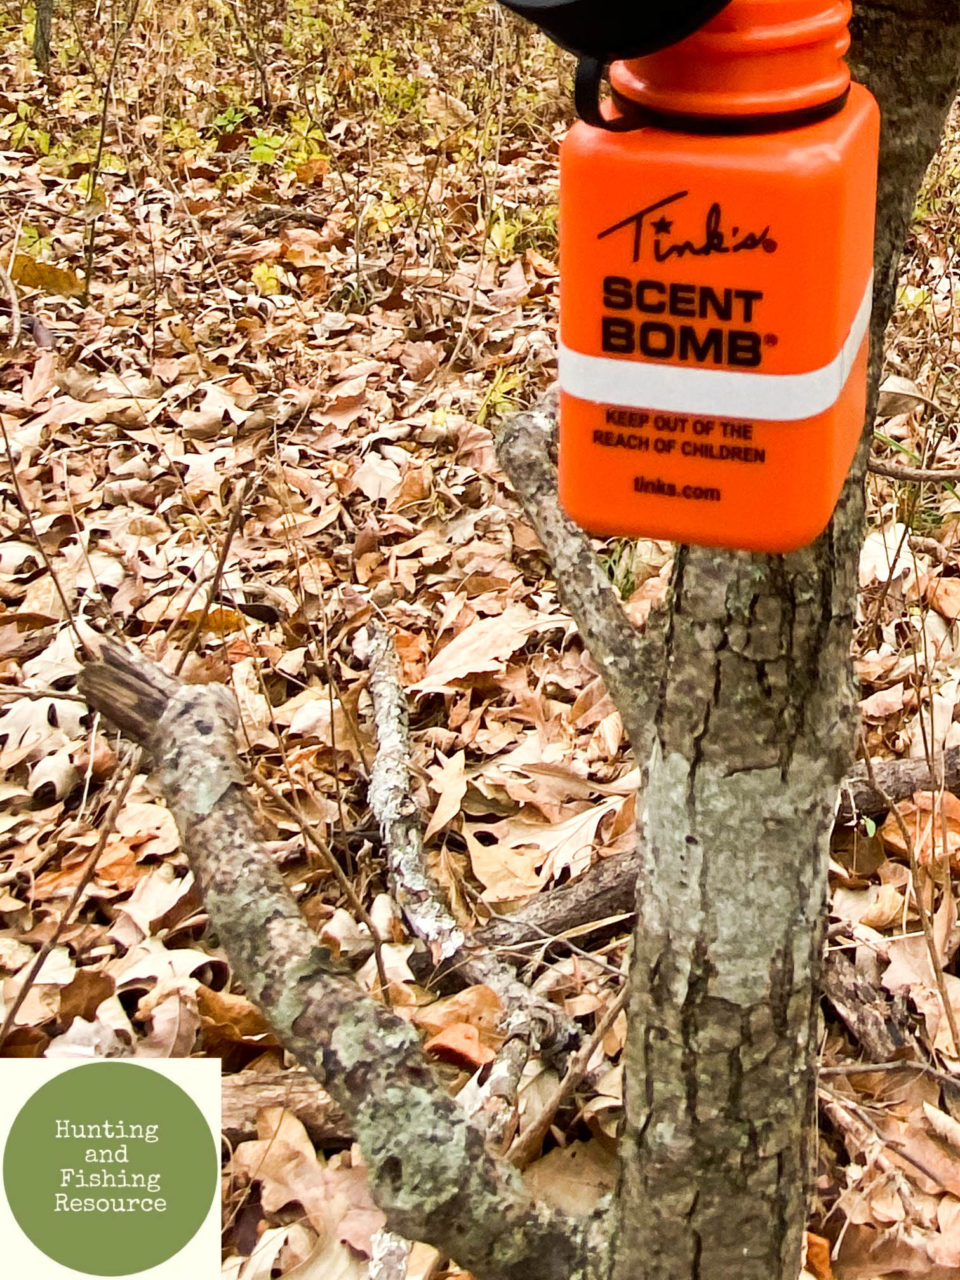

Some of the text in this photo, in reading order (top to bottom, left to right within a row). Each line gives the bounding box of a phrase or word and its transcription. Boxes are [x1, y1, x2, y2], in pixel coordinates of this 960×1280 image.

[602, 275, 764, 323] SCENT
[605, 409, 754, 441] KEEP OUT OF THE
[592, 429, 766, 464] REACH OF CHILDREN
[633, 476, 722, 503] tinks.com
